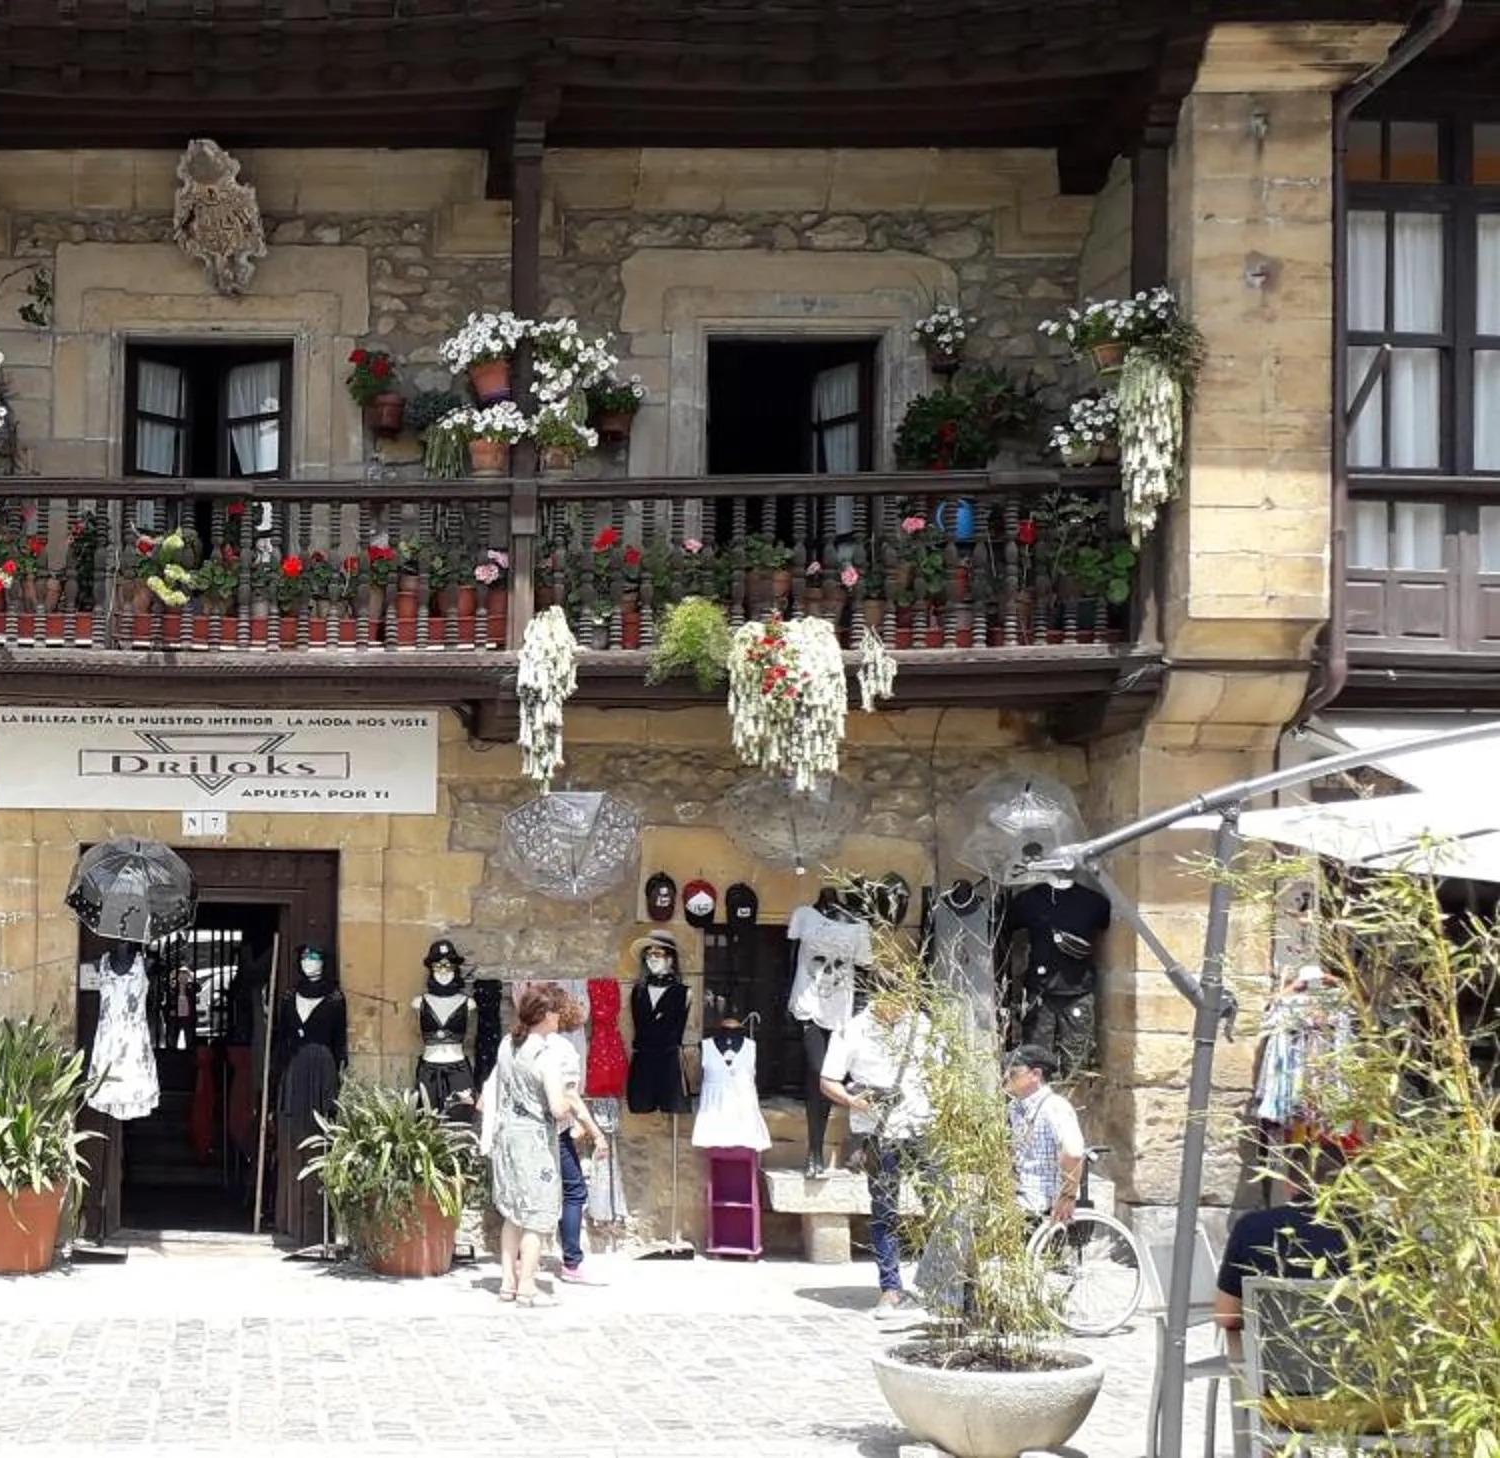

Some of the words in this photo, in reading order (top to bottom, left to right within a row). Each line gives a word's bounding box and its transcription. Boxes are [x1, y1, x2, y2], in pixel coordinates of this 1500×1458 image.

[1, 714, 18, 724] LA
[21, 714, 77, 724] BELLEZA
[80, 712, 113, 724] ESTÁ
[117, 715, 135, 725] EN
[139, 715, 205, 726] NUESTRO
[207, 716, 273, 727] INTERIOR
[286, 716, 304, 727] LA
[307, 717, 352, 727] MODA
[355, 717, 387, 727] NOS
[390, 717, 429, 727] VISTE
[240, 788, 322, 799] APUESTA
[327, 789, 368, 799] POR
[374, 789, 390, 800] TI
